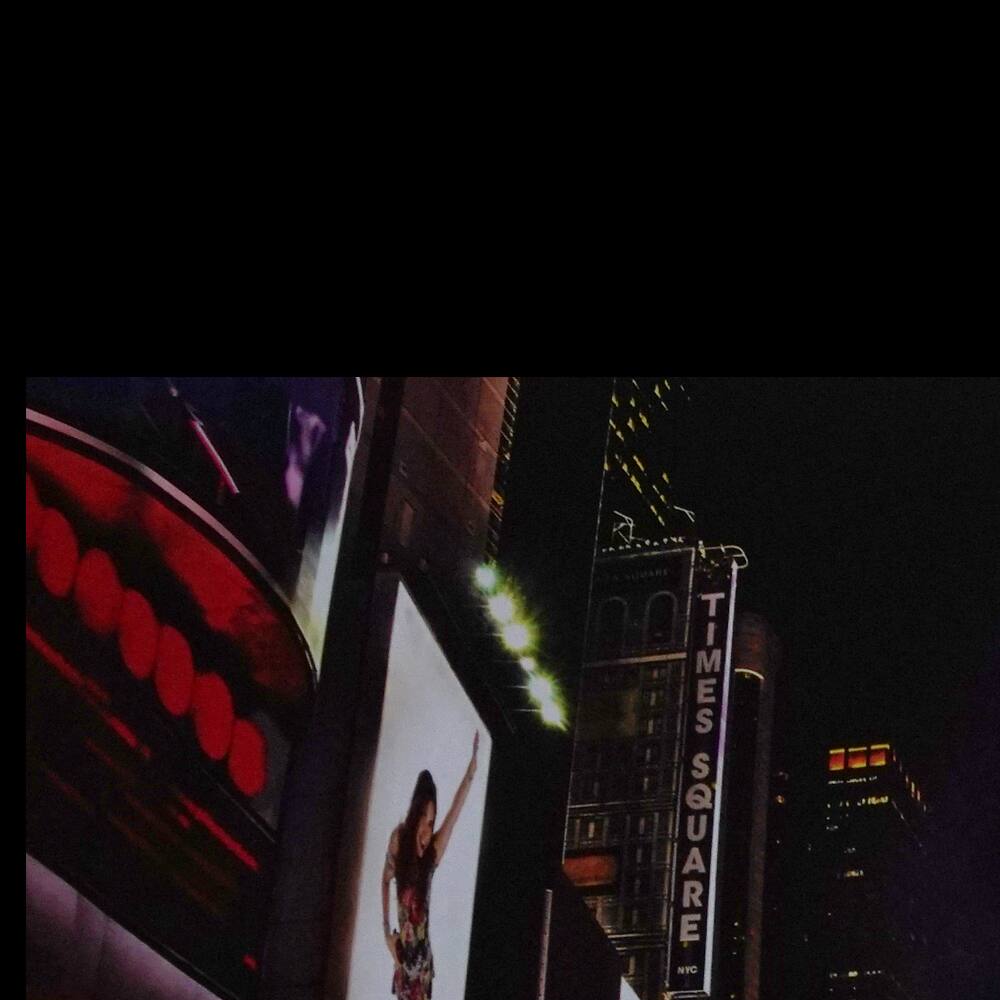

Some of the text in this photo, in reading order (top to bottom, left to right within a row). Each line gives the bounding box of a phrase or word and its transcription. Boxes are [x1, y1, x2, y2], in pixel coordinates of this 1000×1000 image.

[679, 592, 726, 943] TIMES SQUARE
[676, 964, 699, 975] NYC
